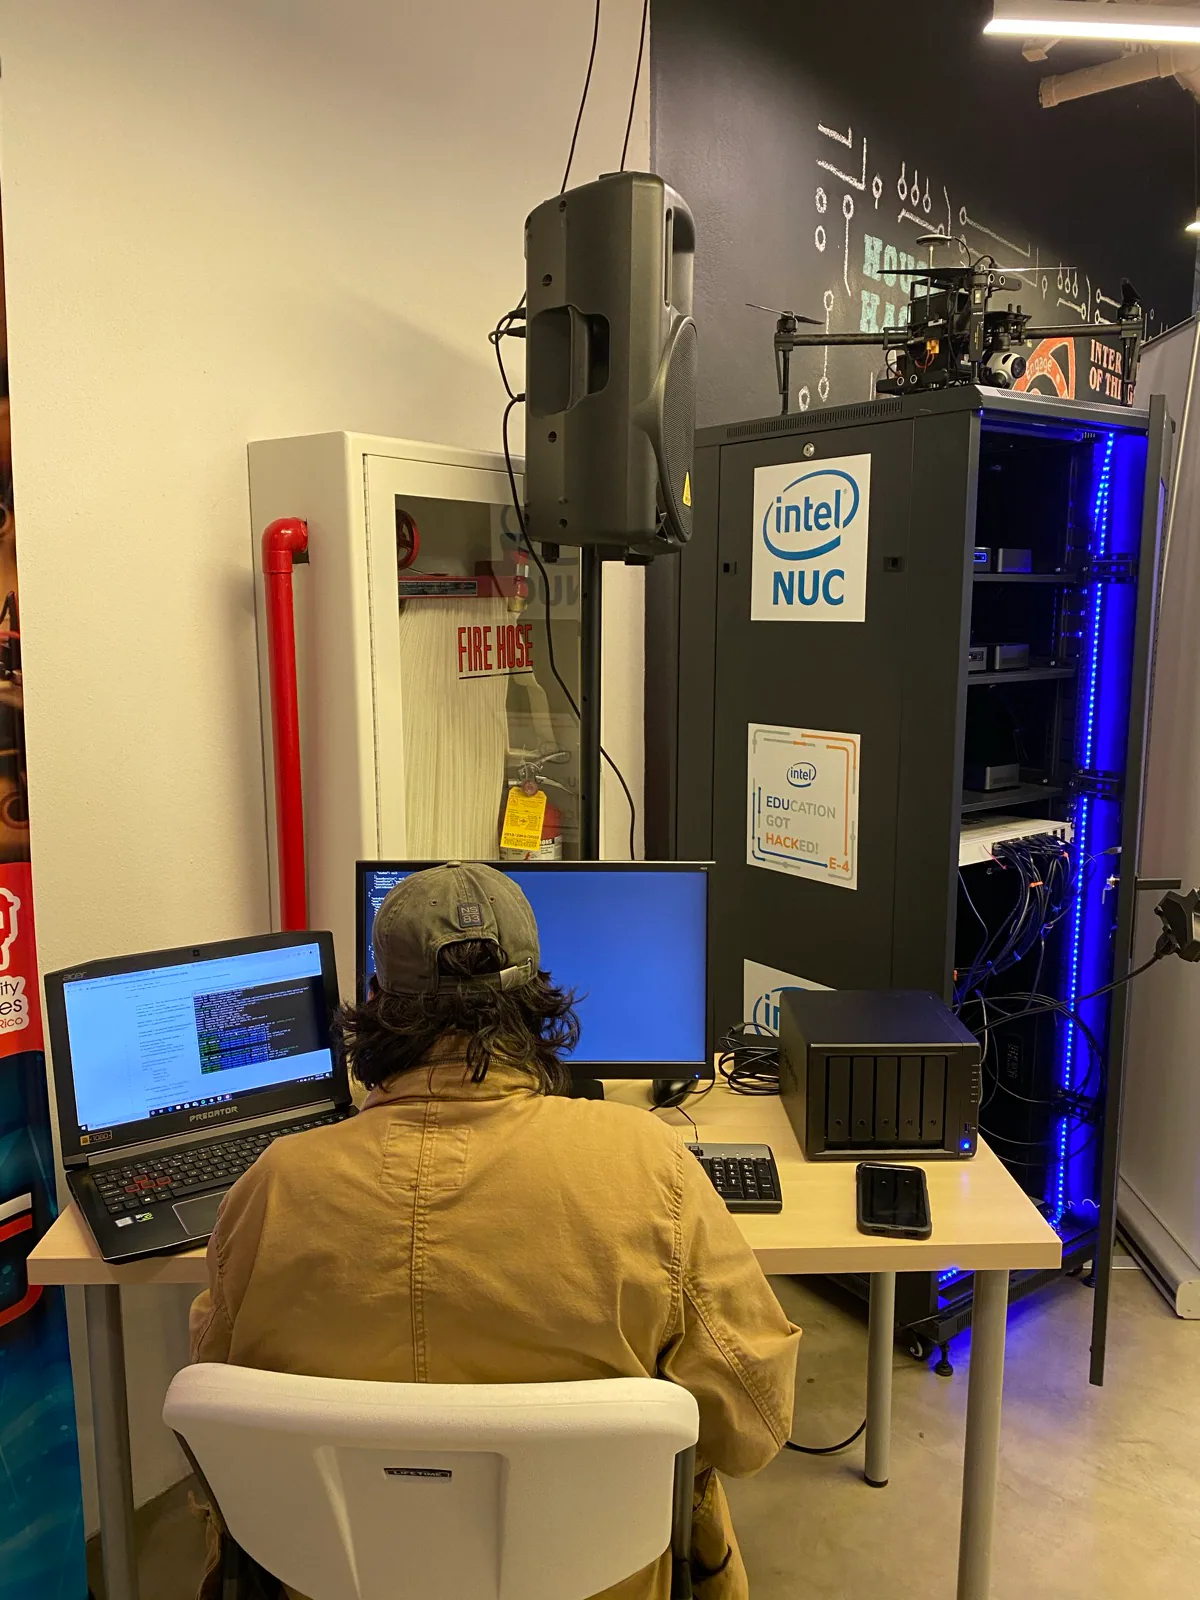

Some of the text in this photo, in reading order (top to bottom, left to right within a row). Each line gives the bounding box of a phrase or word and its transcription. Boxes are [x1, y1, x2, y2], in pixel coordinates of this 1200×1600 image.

[1026, 356, 1053, 379] Engage
[1089, 366, 1134, 405] OF THIG
[775, 489, 841, 534] intel
[772, 568, 845, 606] NUC
[457, 624, 533, 673] FIRE HOSE
[790, 766, 813, 781] intel
[766, 795, 836, 819] EDUCATION
[766, 814, 791, 829] GOT
[766, 832, 819, 855] HACKED!
[829, 857, 850, 873] E-4
[460, 906, 478, 914] NS
[463, 914, 480, 923] 83
[62, 971, 88, 981] acer
[189, 1106, 239, 1122] PREDATOR
